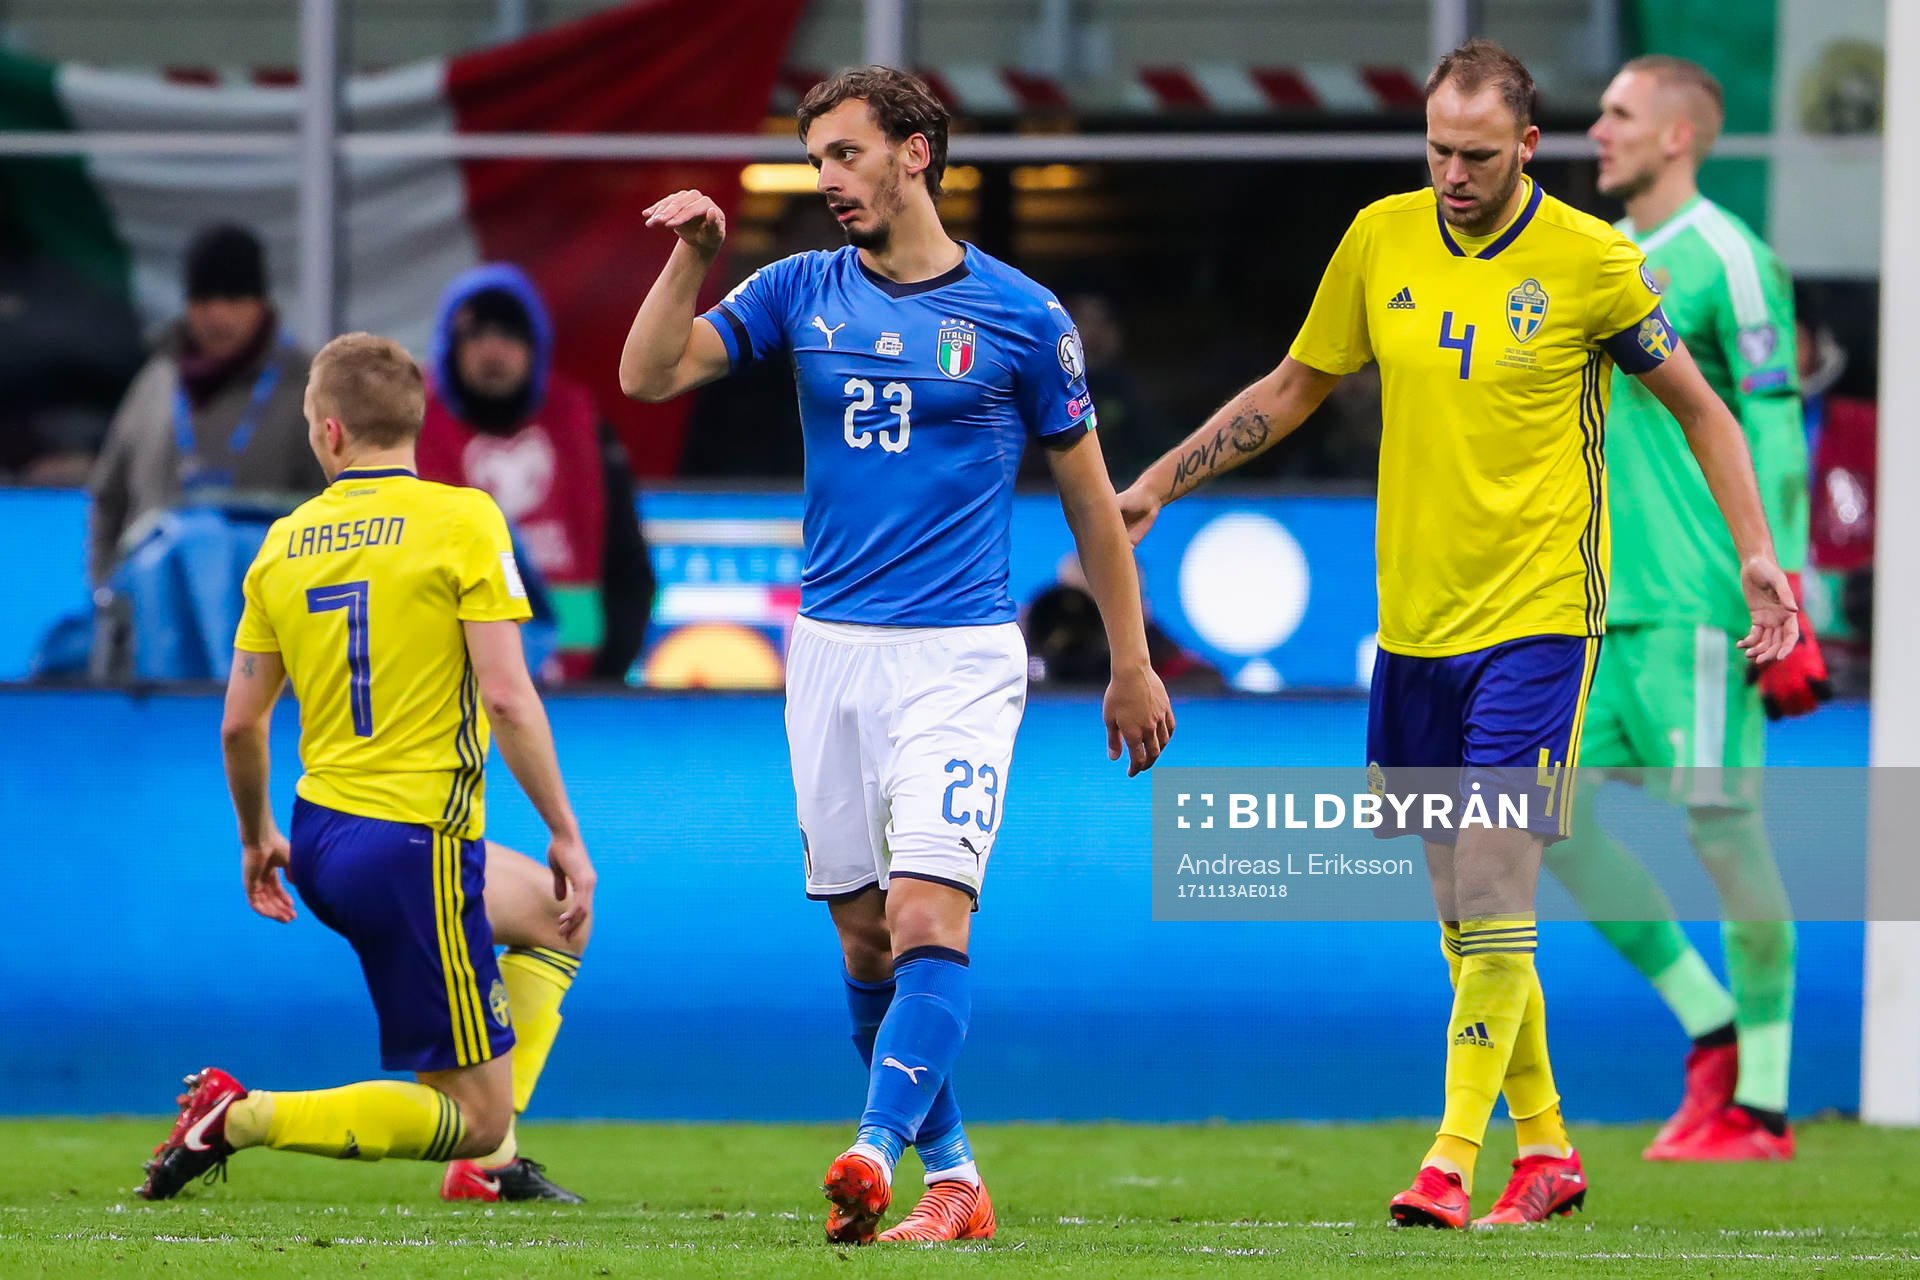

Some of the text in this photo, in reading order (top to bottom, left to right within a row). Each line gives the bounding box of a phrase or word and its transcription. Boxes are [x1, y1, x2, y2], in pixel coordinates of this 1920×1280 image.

[941, 331, 973, 342] ITALIA
[1438, 311, 1476, 380] 4
[843, 377, 912, 453] 23
[305, 580, 373, 738] 7
[942, 758, 998, 834] 23
[1536, 747, 1562, 818] 4
